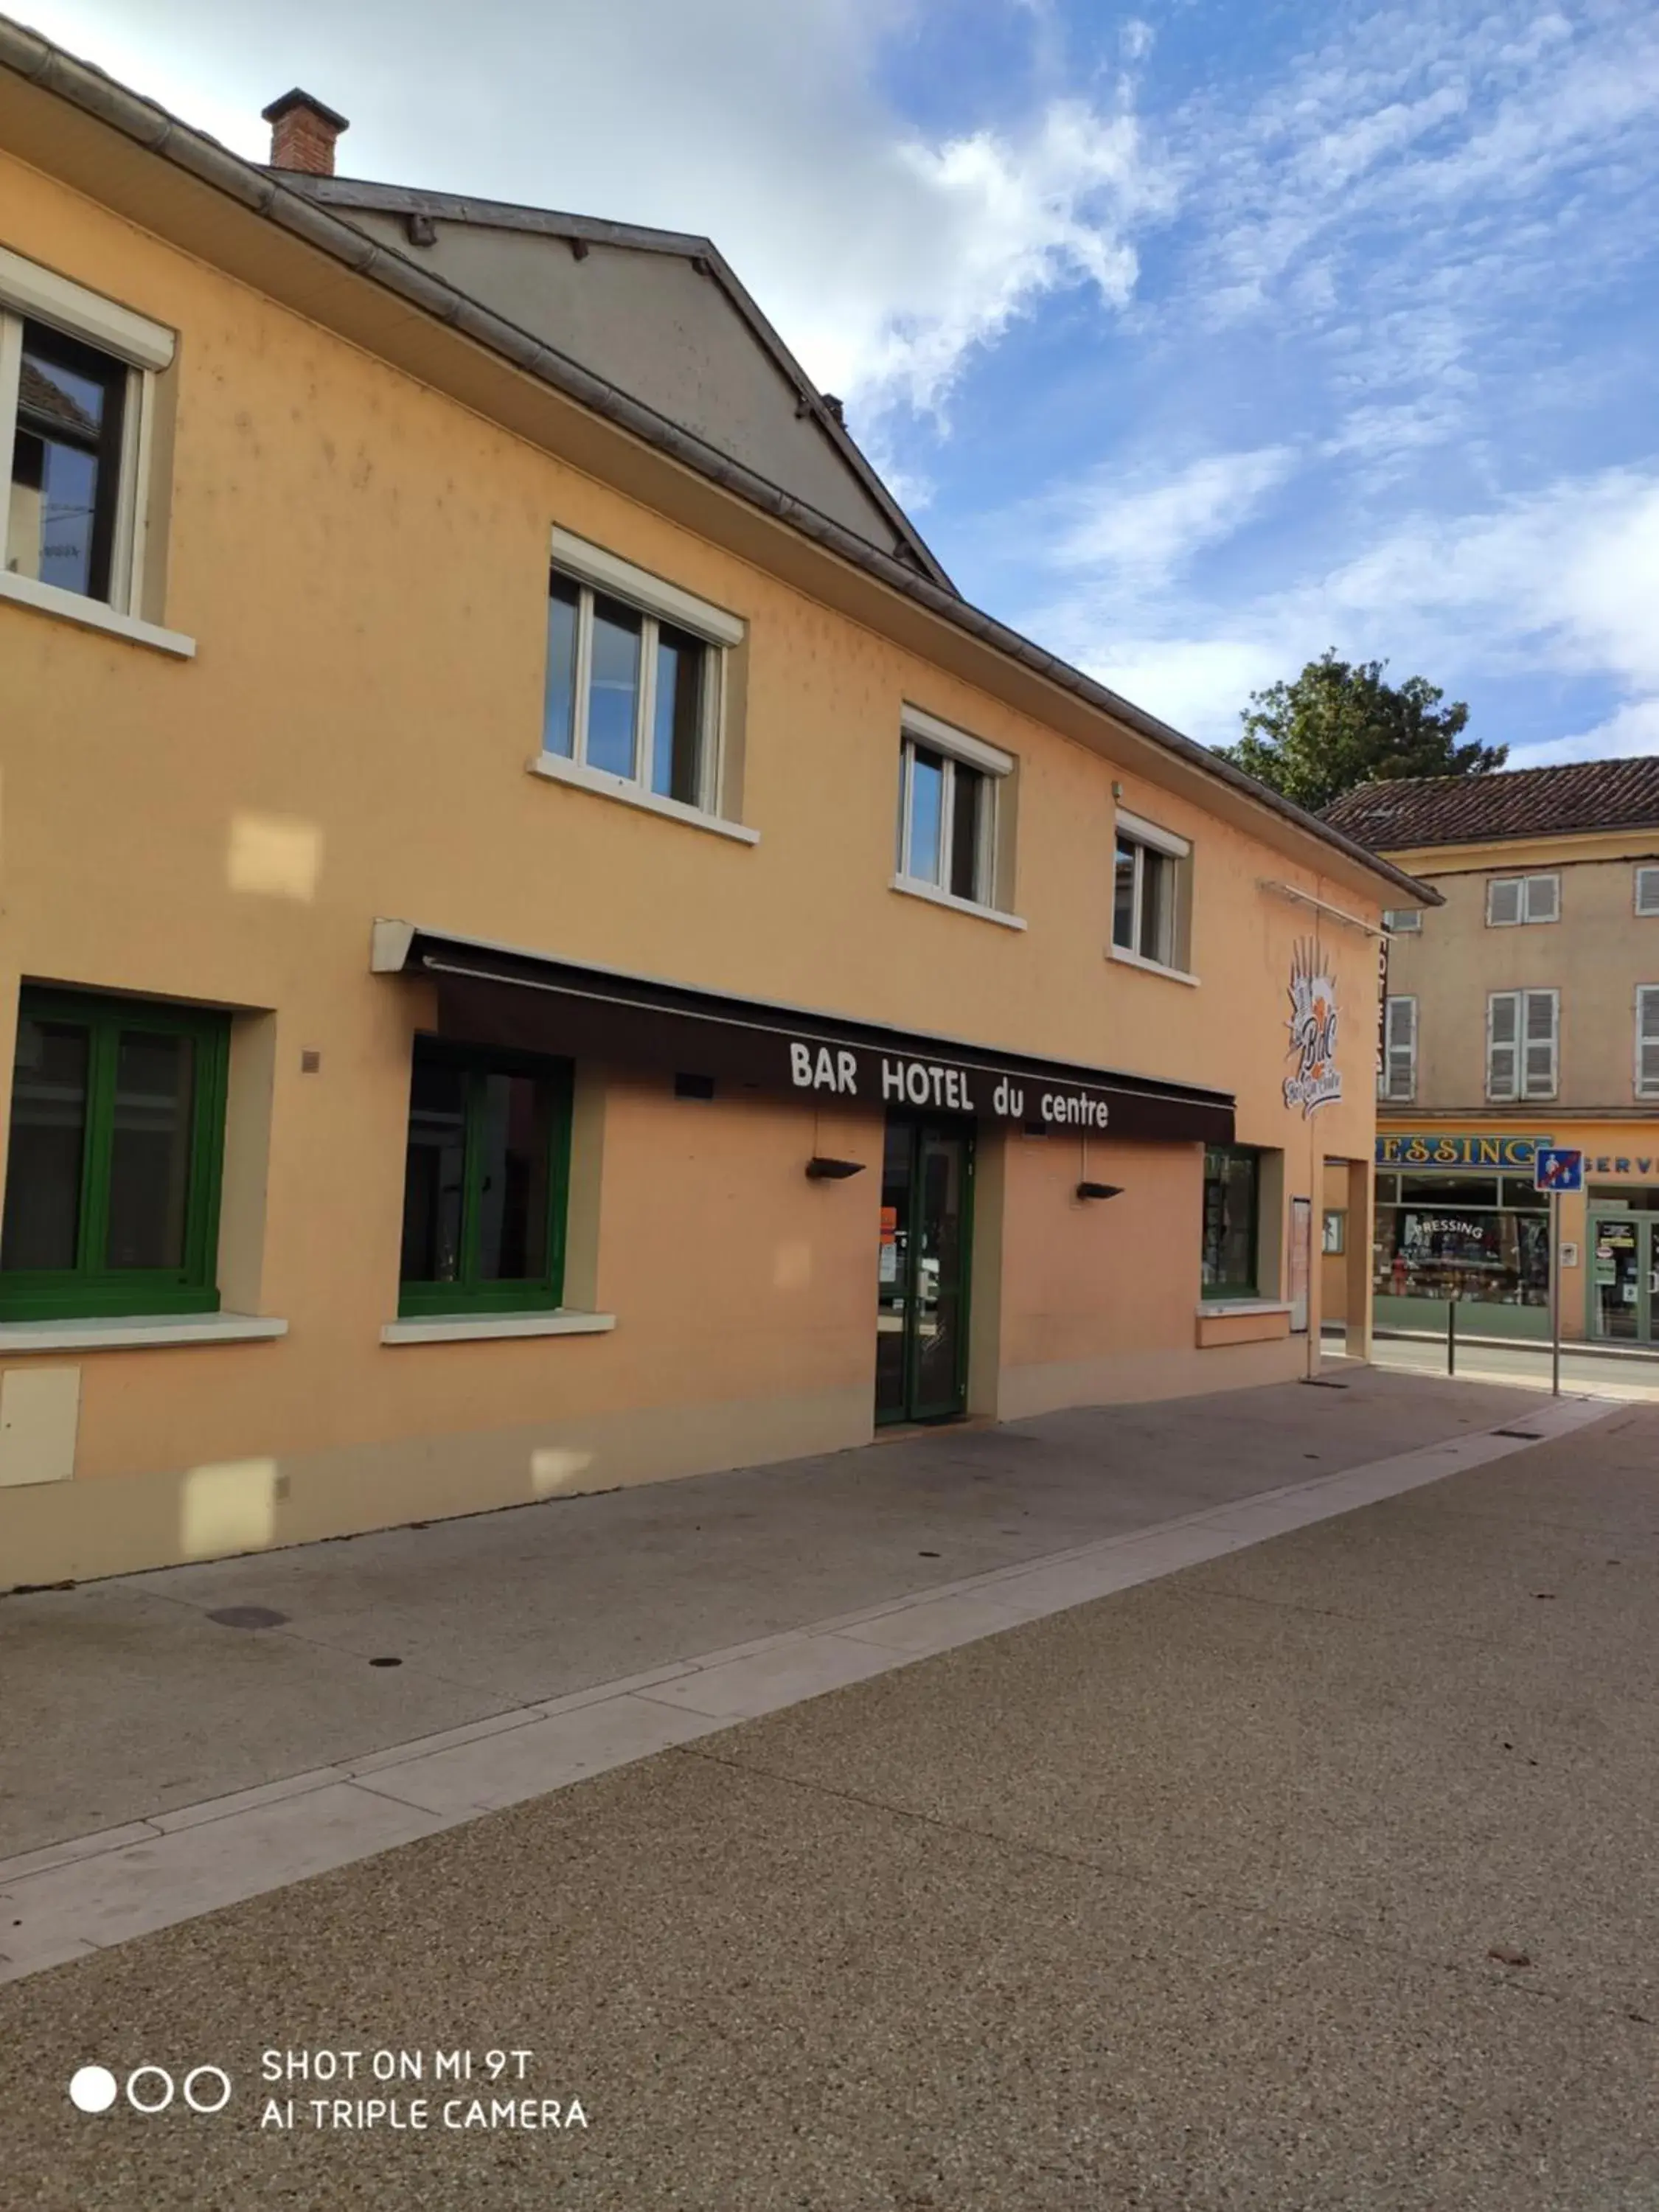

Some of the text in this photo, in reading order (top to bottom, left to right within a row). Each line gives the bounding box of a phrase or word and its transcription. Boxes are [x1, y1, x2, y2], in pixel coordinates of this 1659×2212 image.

[790, 1042, 1109, 1128] BAR HOTEL du centre
[1414, 1219, 1484, 1239] PRESSING
